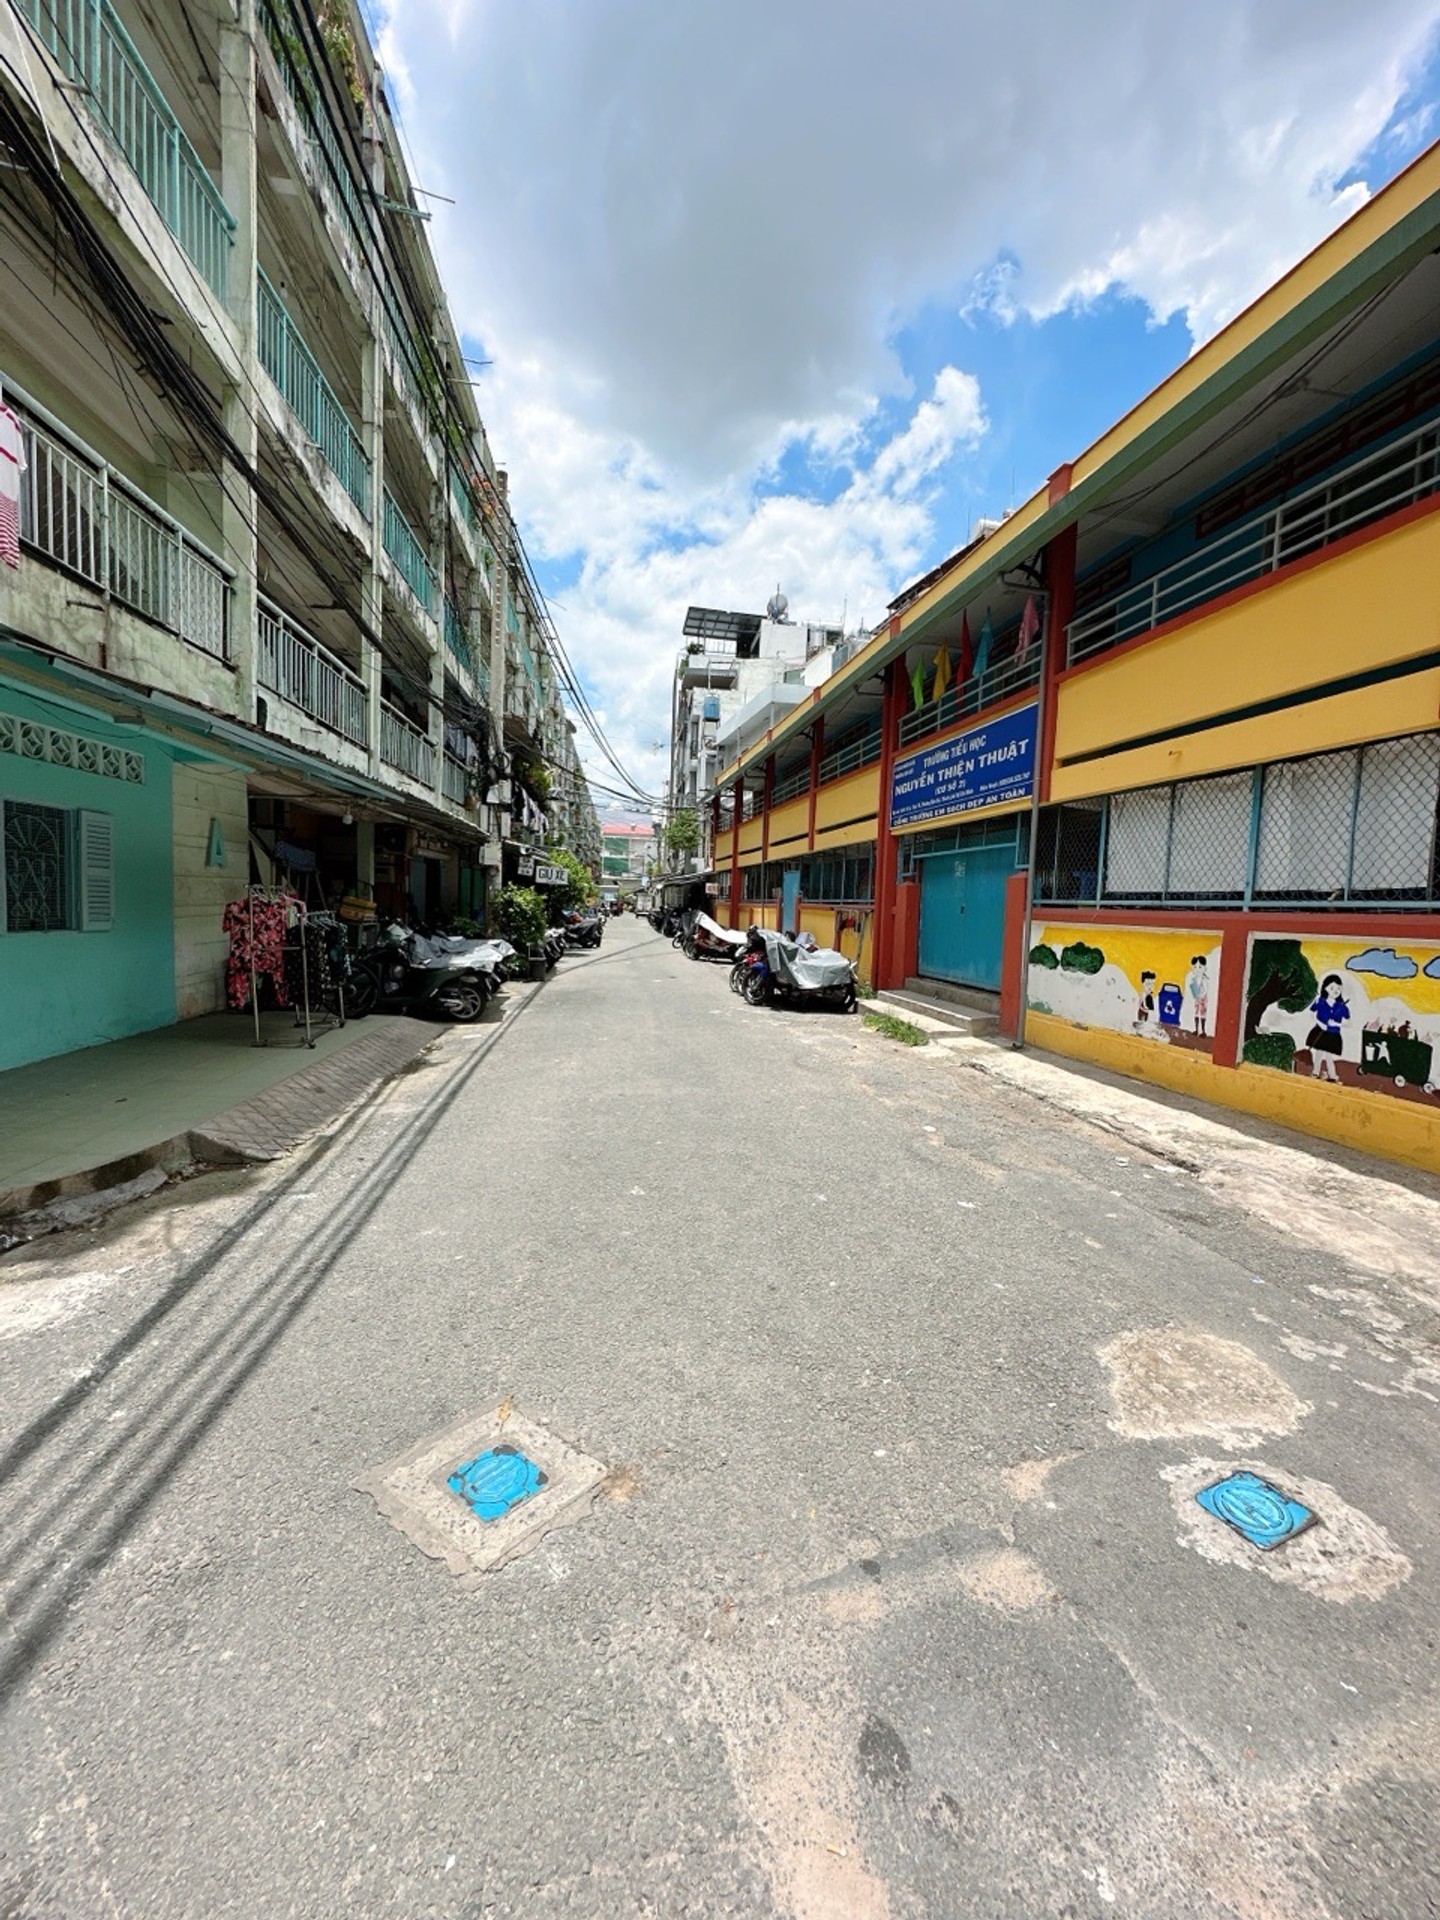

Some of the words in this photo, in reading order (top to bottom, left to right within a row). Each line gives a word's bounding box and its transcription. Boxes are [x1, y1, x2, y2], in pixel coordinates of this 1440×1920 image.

[894, 771, 935, 796] NGUYỄN
[938, 759, 975, 782] THIỆN
[978, 739, 1029, 768] THUẬT
